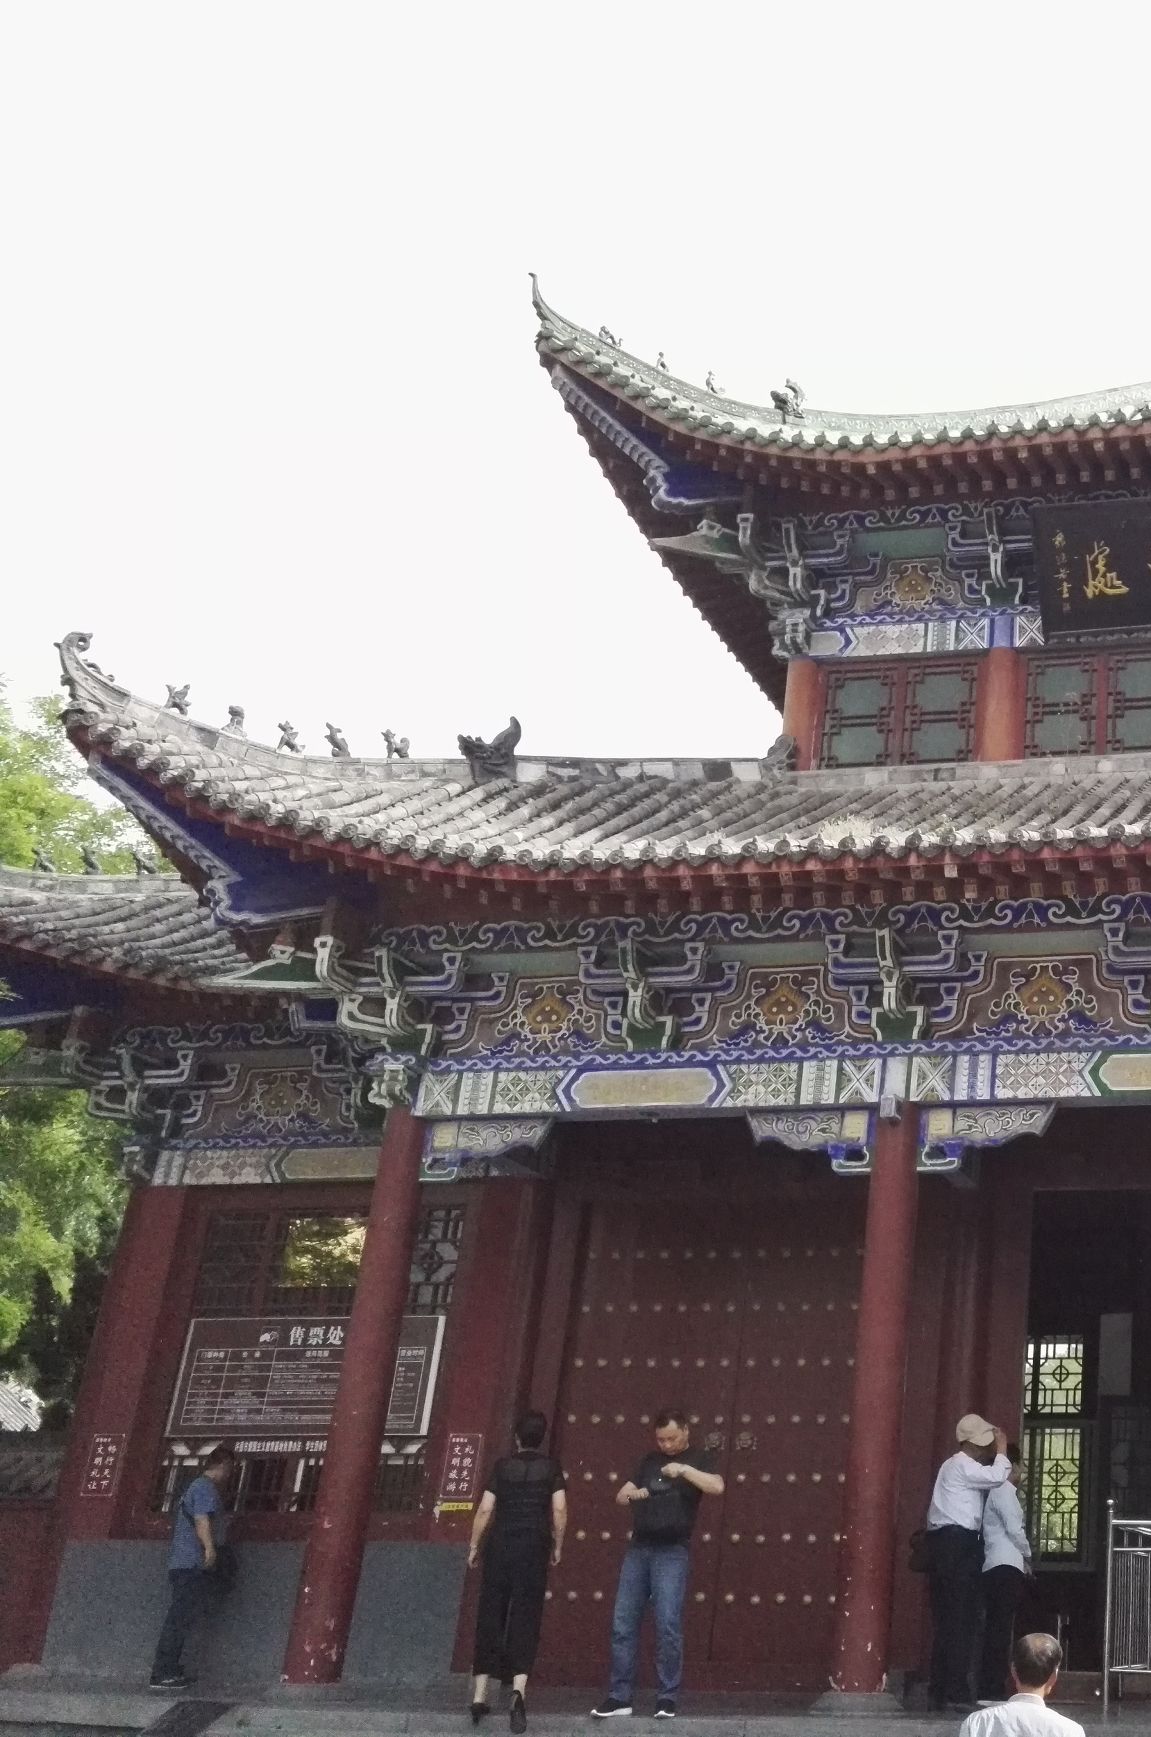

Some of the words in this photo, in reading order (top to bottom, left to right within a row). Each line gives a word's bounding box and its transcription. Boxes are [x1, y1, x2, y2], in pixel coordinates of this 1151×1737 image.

[289, 1325, 344, 1346] 售票处
[446, 1445, 461, 1492] 文明旅游
[459, 1445, 475, 1492] 礼貌先行
